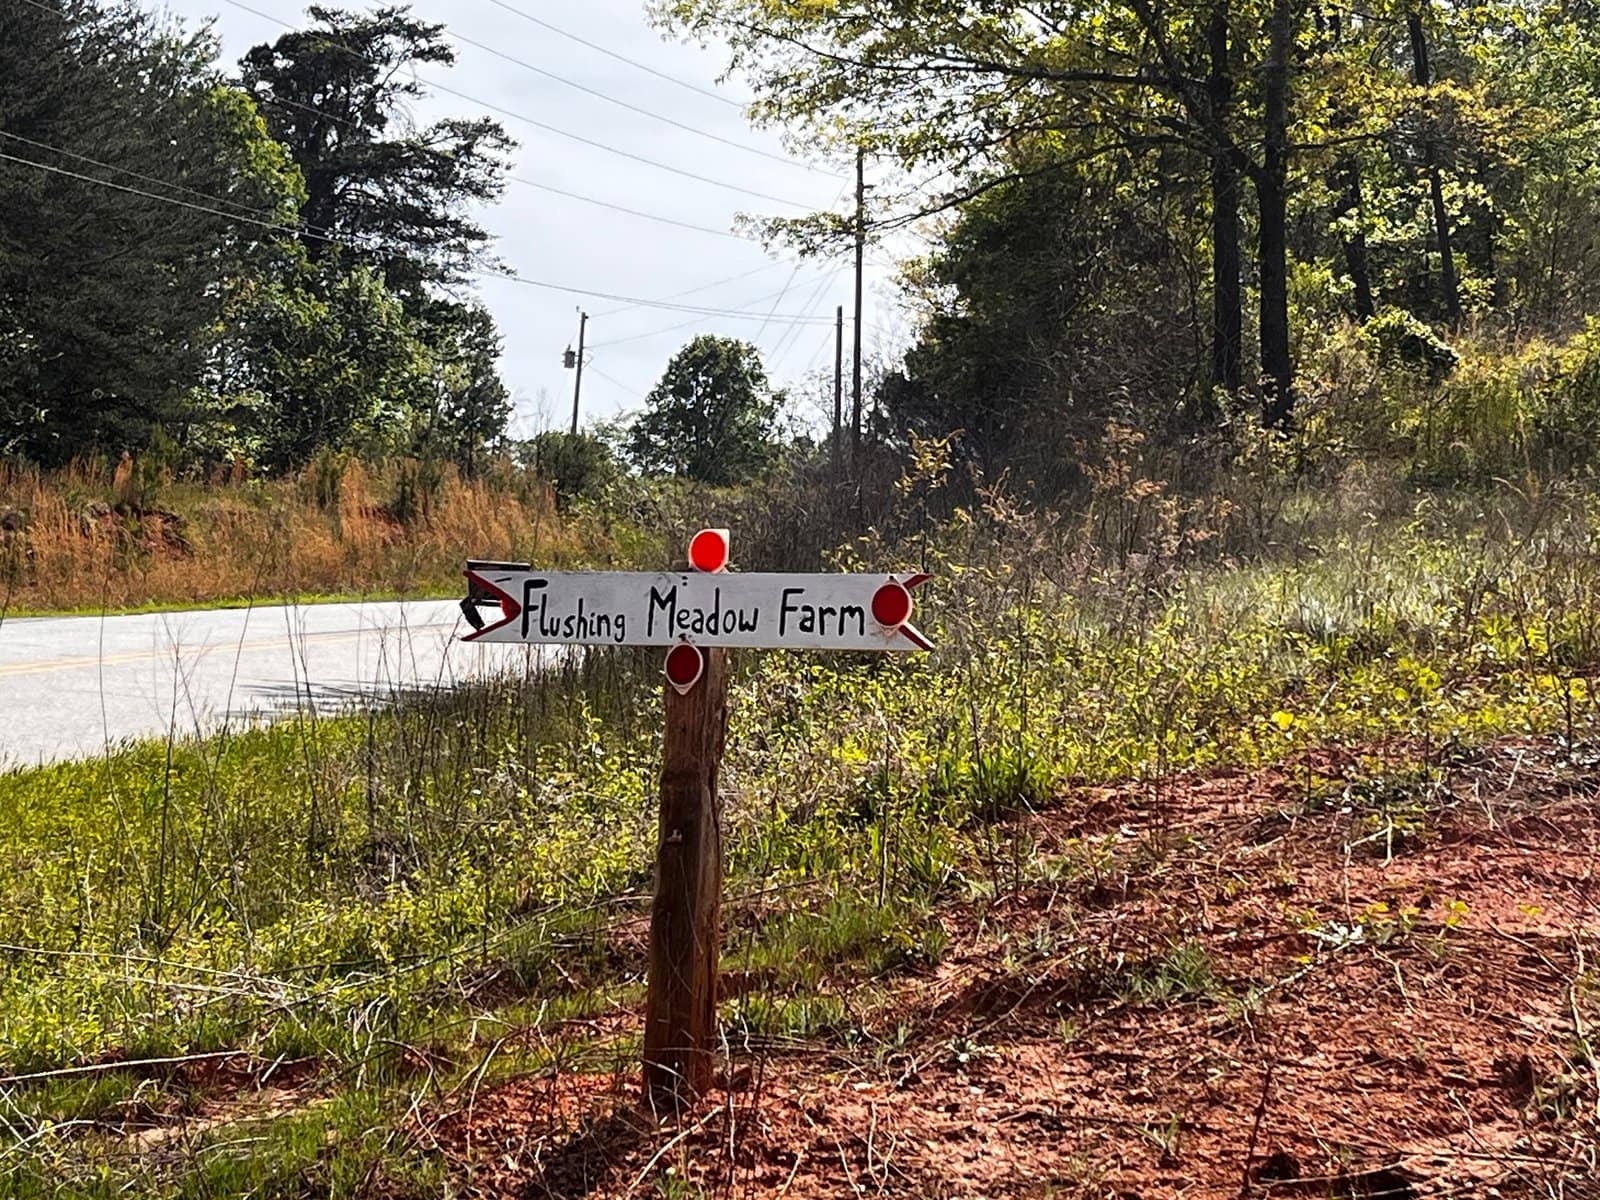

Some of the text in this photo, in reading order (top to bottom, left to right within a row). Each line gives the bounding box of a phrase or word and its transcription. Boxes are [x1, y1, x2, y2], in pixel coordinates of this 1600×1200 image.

[521, 579, 865, 642] Flushing Meadow Farm
